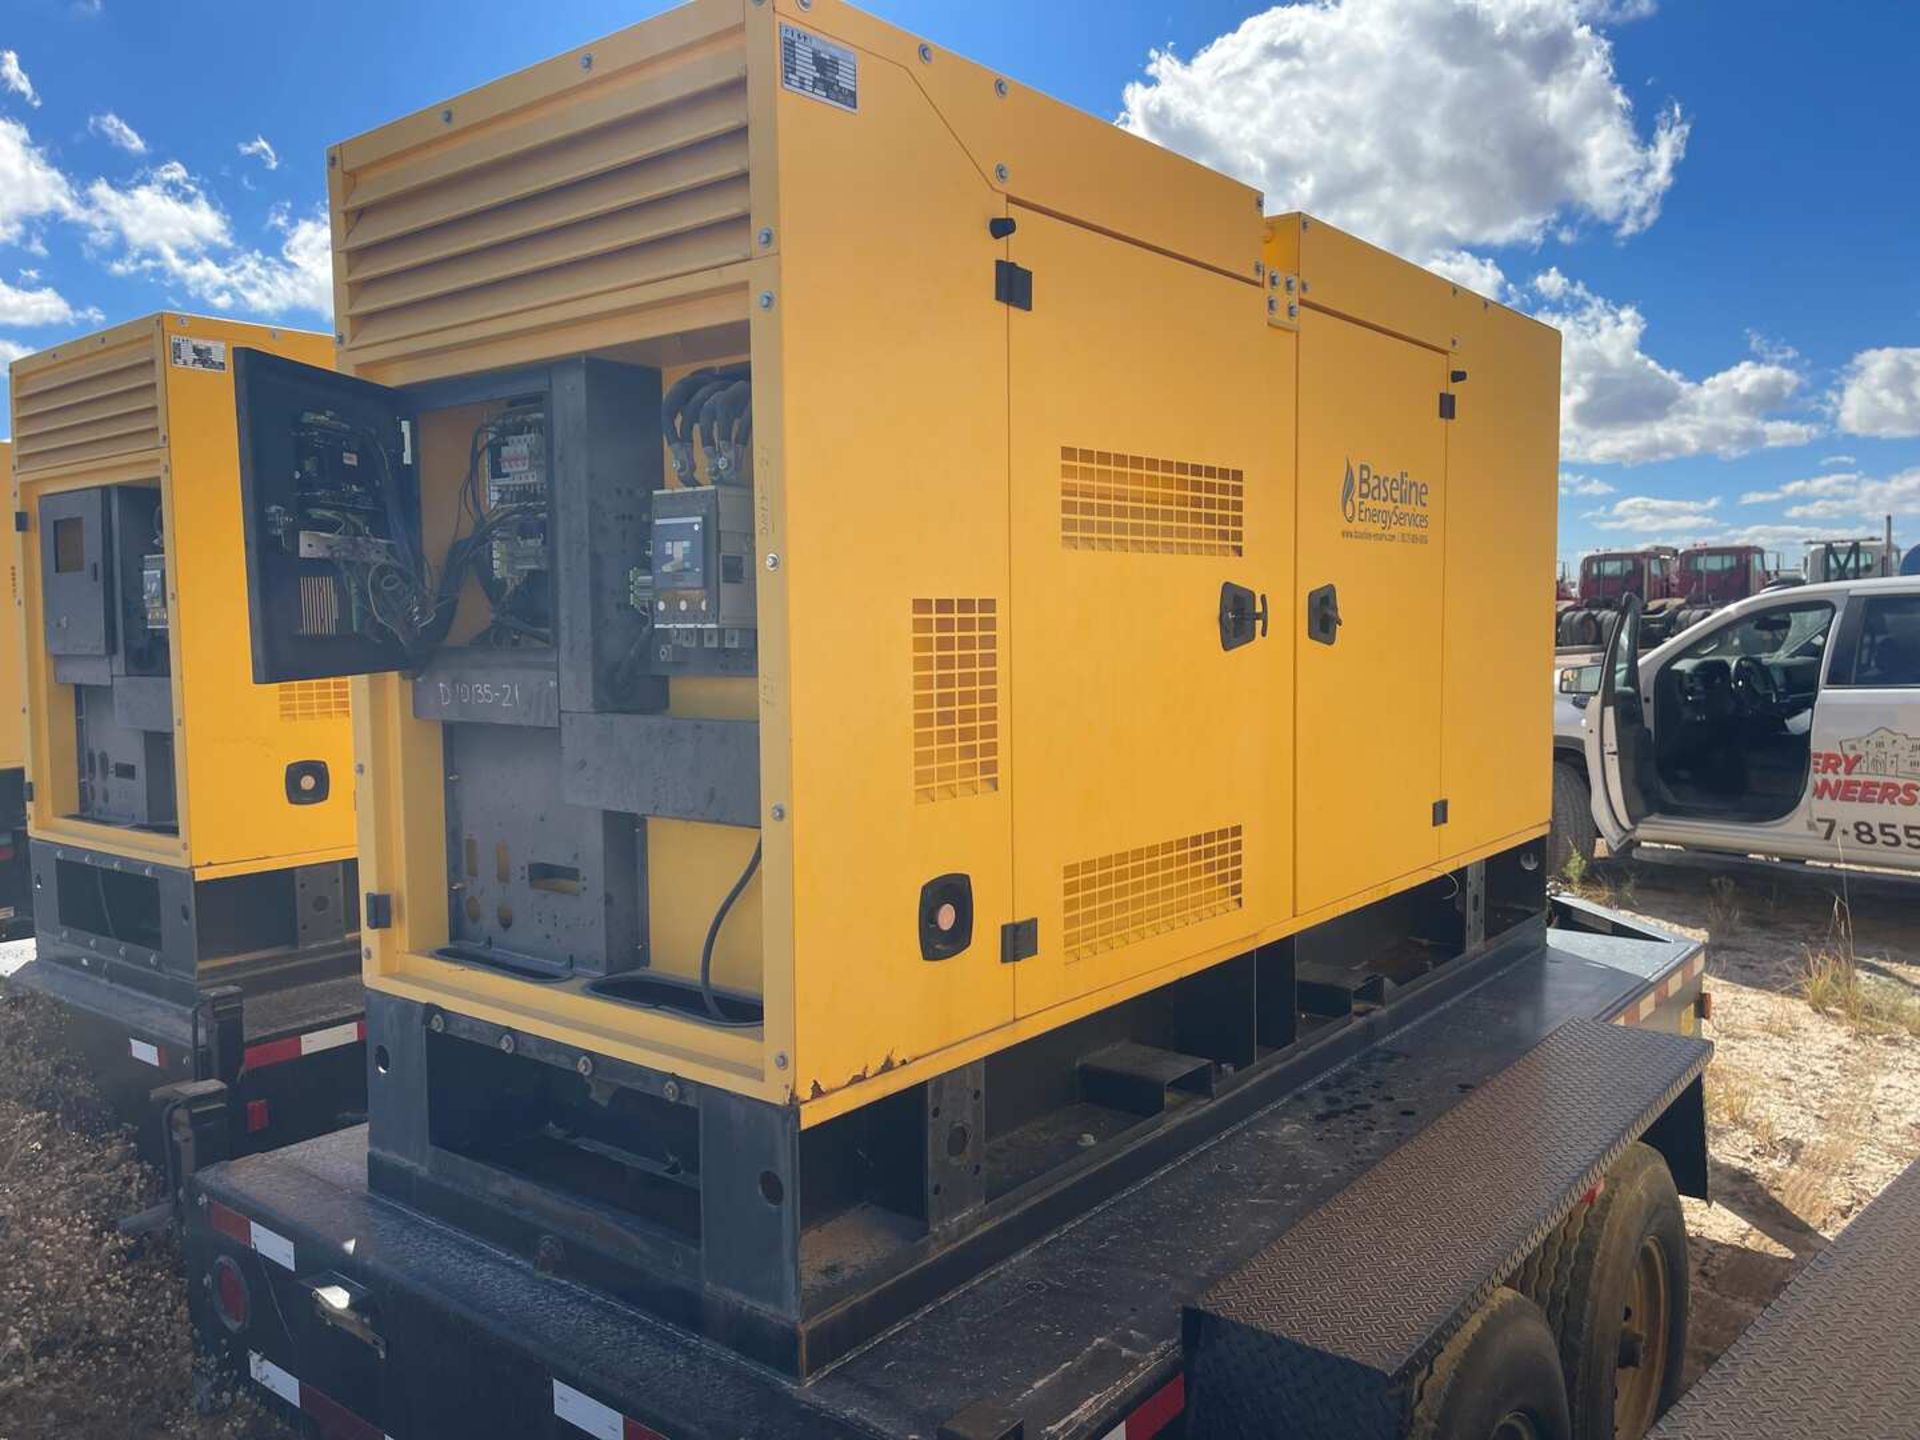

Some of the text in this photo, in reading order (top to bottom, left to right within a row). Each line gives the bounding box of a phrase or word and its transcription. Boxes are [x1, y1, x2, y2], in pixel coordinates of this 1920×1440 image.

[1358, 463, 1429, 507] Baseline
[1358, 501, 1429, 531] EnergyServices
[1812, 778, 1919, 806] NEERS
